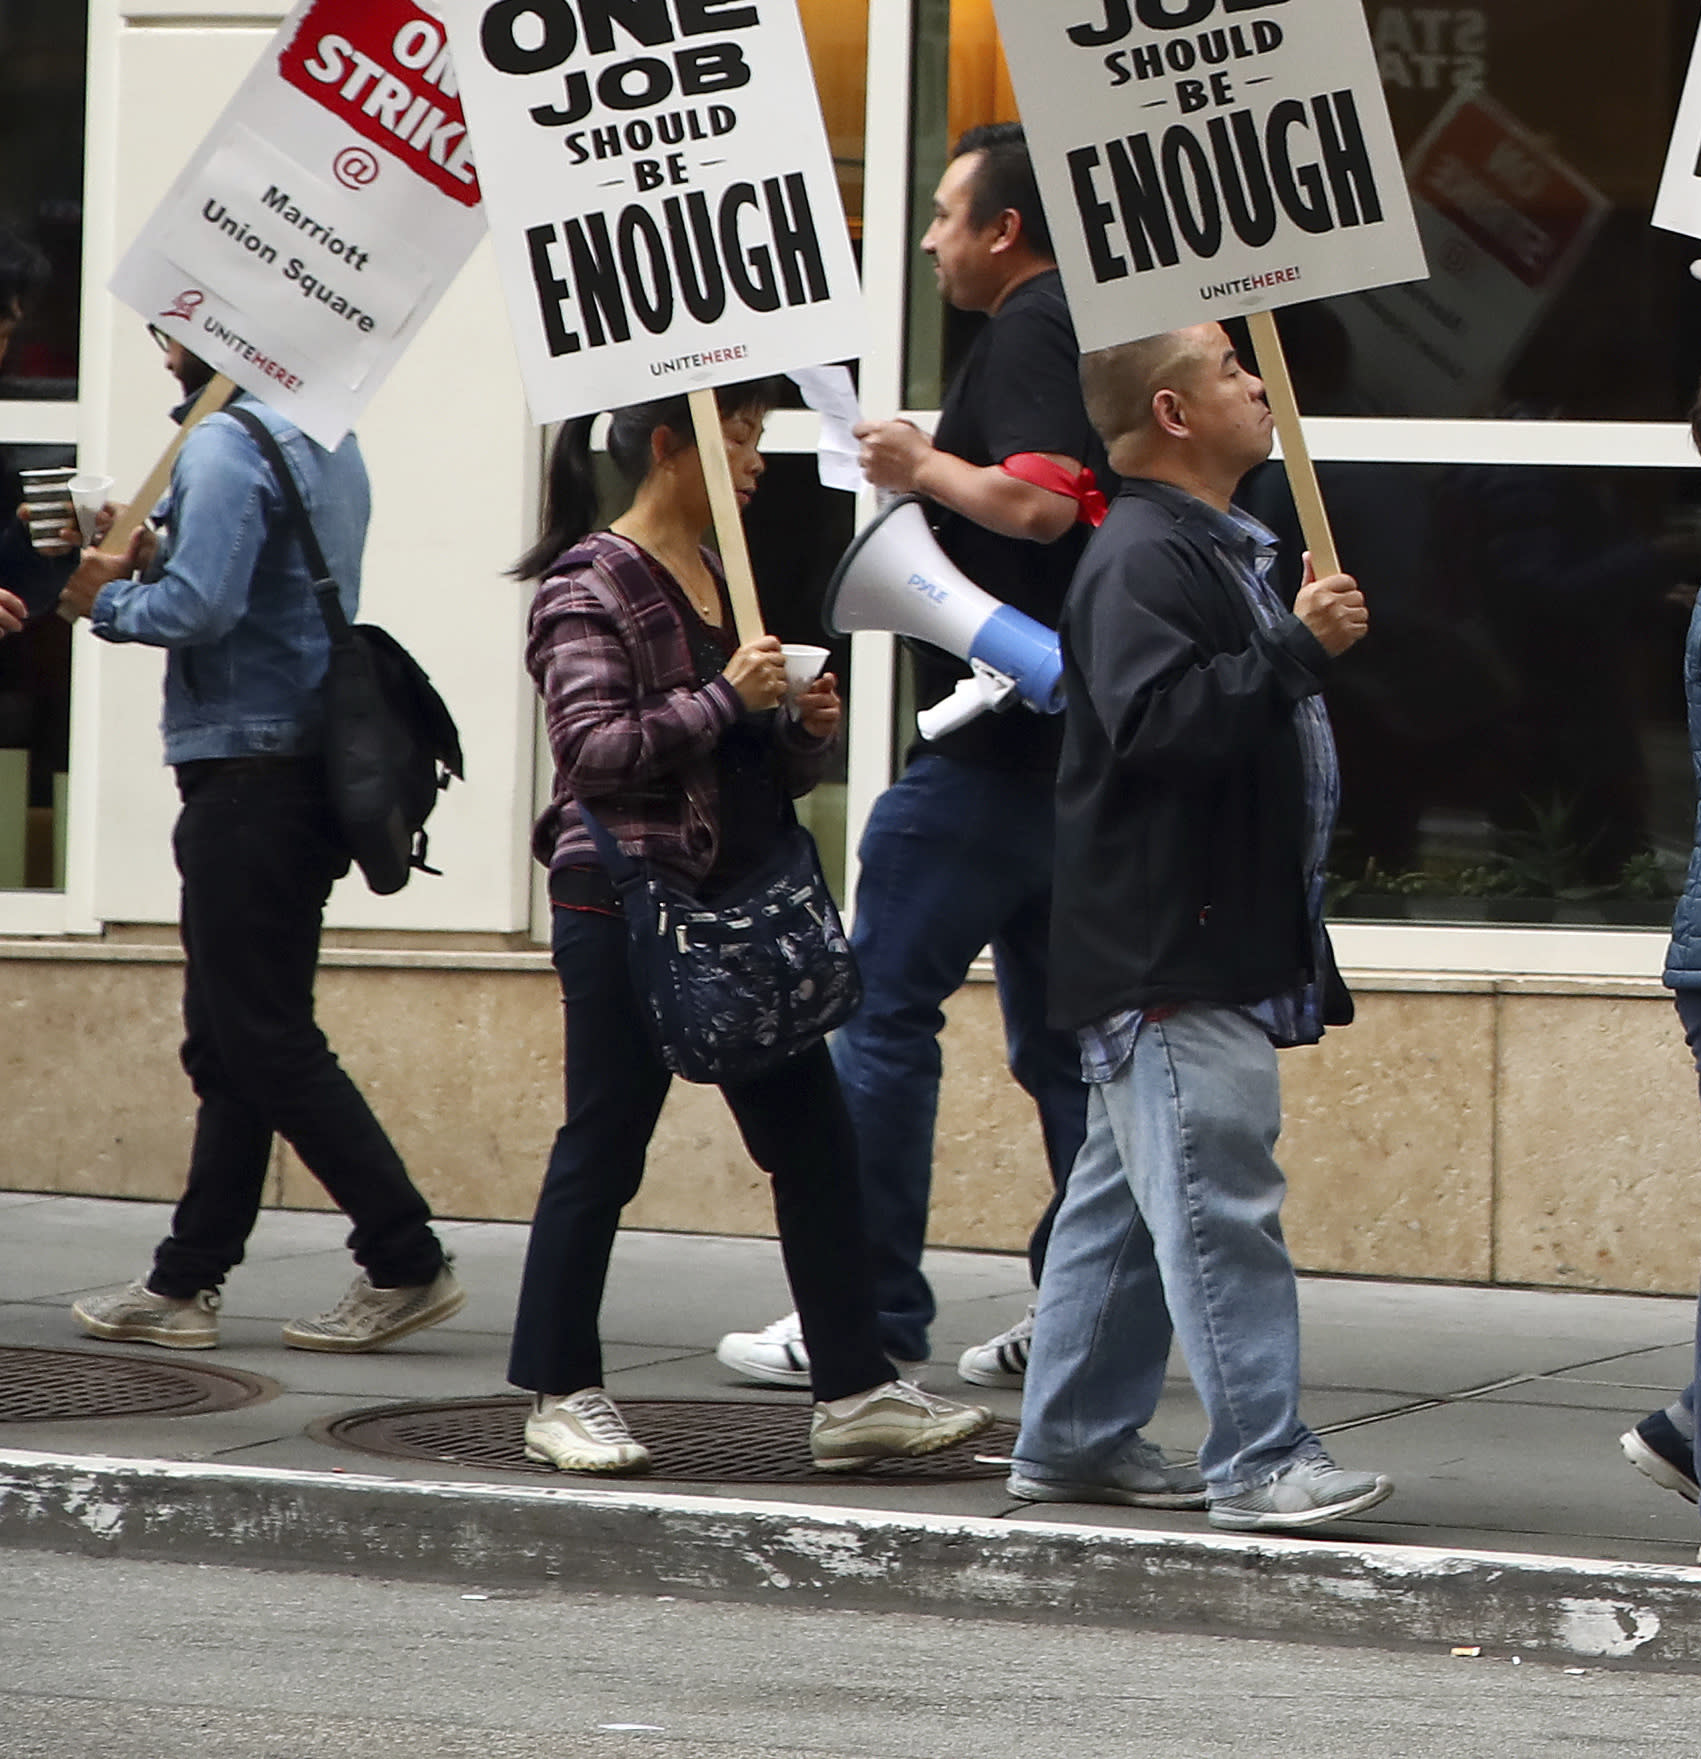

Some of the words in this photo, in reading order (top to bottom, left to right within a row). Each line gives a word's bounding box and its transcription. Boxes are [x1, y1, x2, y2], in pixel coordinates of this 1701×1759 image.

[530, 43, 750, 126] JOB
[1104, 21, 1283, 86] SHOULD
[1175, 71, 1235, 114] BE
[333, 146, 380, 190] @
[566, 106, 736, 164] SHOULD
[634, 153, 688, 192] BE
[1067, 89, 1384, 283] ENOUGH
[260, 183, 370, 273] Marriott
[527, 173, 830, 357] ENOUGH
[202, 197, 279, 264] Union
[282, 257, 376, 336] Square
